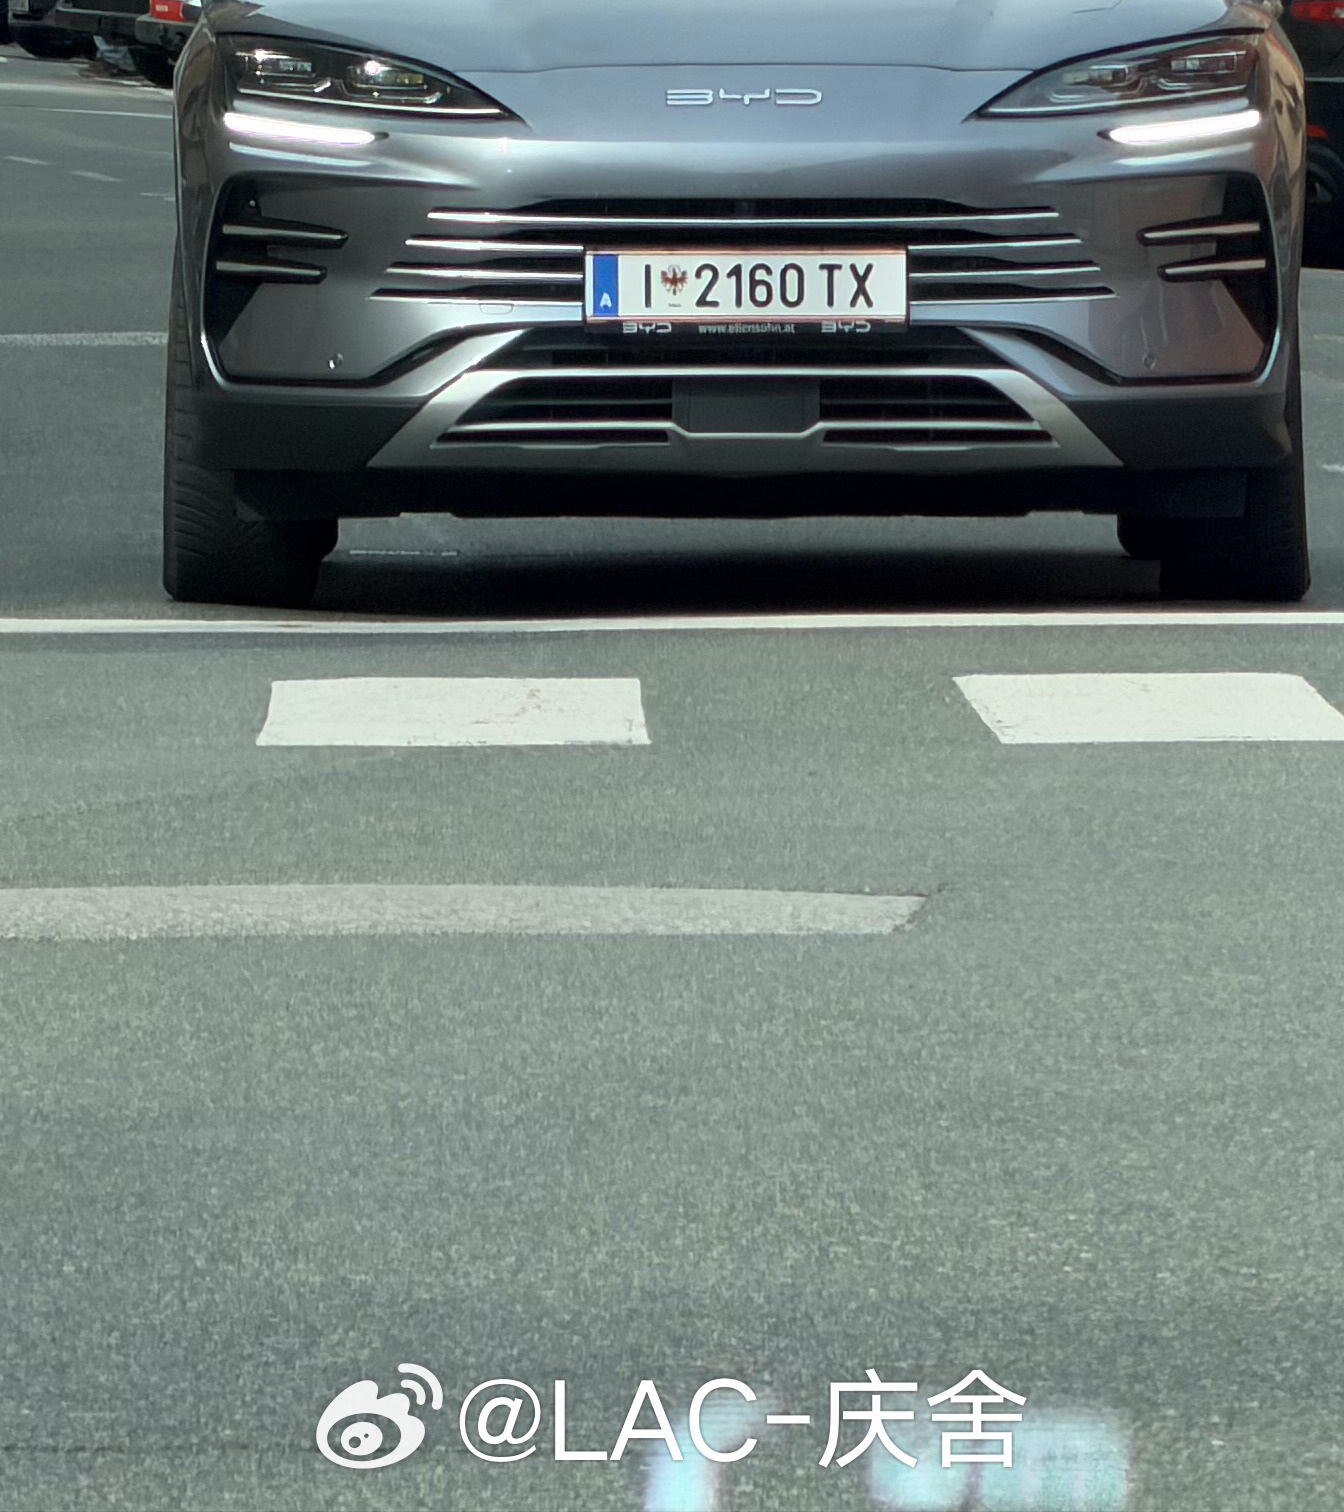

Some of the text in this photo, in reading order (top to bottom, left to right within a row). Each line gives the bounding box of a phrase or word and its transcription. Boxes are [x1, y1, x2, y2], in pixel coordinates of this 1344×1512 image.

[667, 88, 822, 105] BYD
[644, 263, 874, 308] I 2160 TX
[623, 322, 672, 334] BYD
[821, 321, 871, 334] BYD
